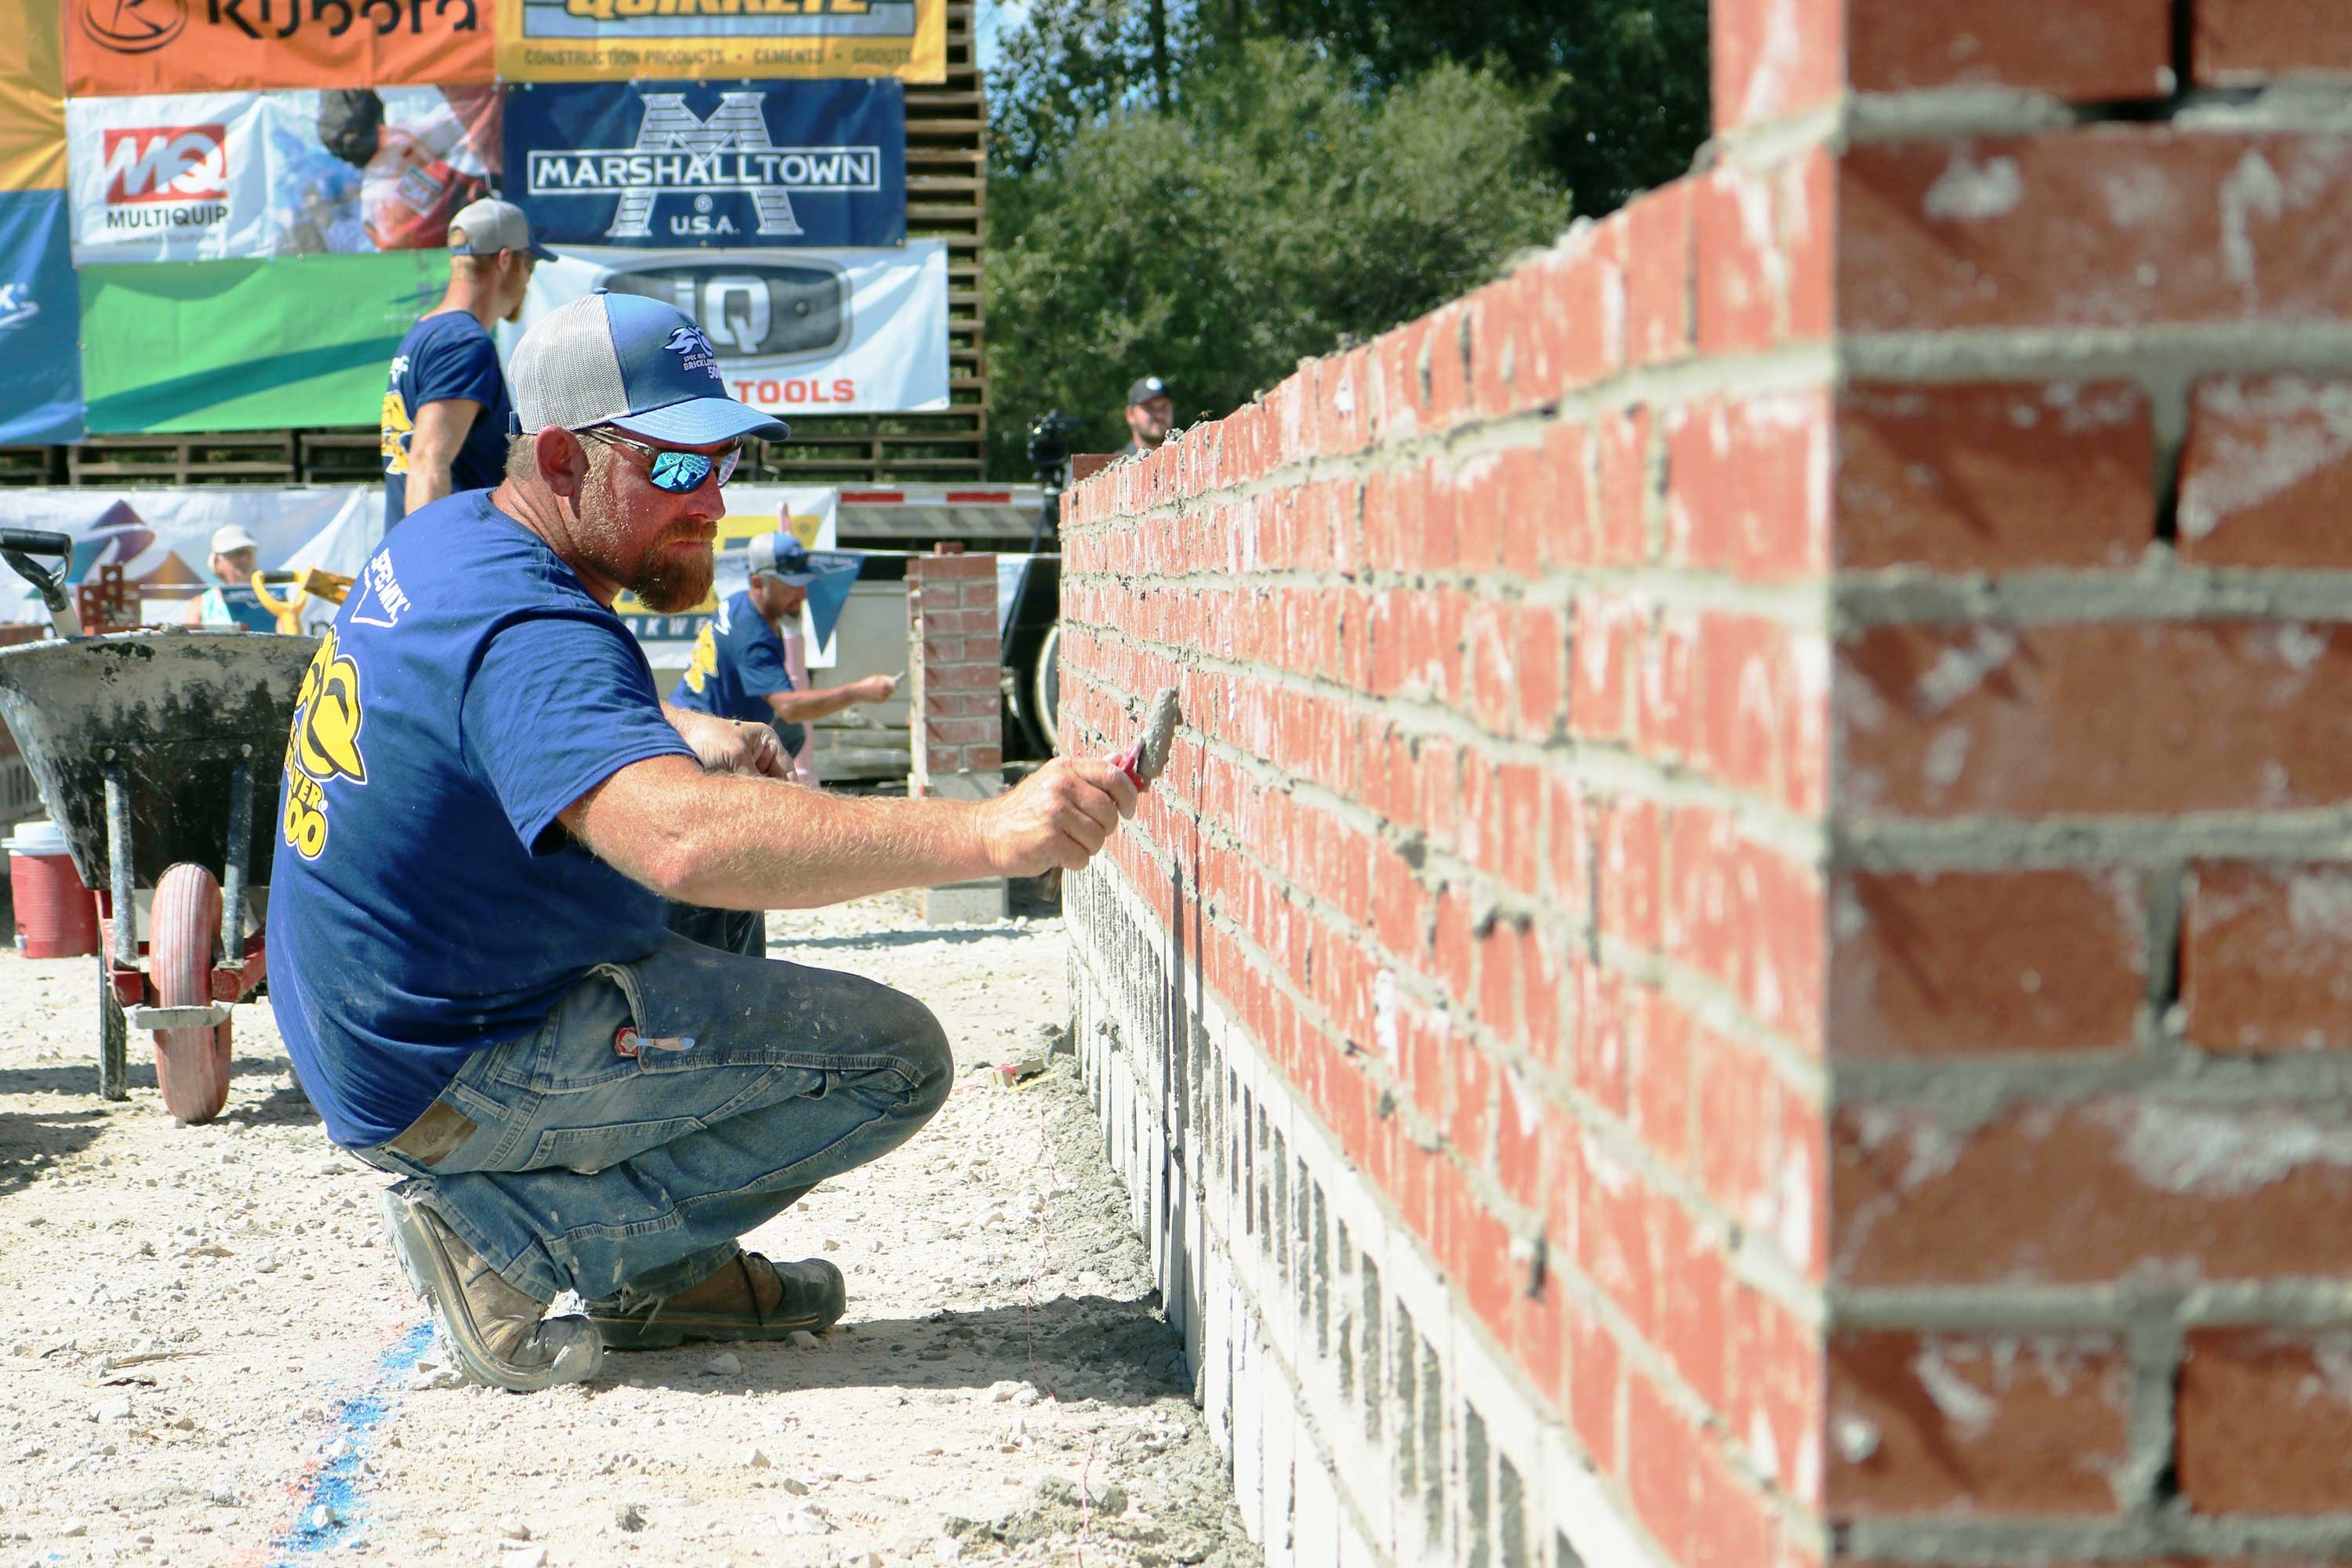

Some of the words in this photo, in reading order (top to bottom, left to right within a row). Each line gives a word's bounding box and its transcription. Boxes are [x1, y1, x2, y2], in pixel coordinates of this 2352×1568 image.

[524, 49, 641, 65] CONSTRUCTION
[644, 49, 724, 64] PRODUCTS
[753, 49, 824, 64] CEMENTS
[105, 132, 227, 195] MQ
[536, 154, 870, 186] MARSHALLTOWN
[107, 205, 228, 228] MULTIQUIP
[670, 215, 740, 235] U.S.A.
[733, 379, 856, 404] TOOLS
